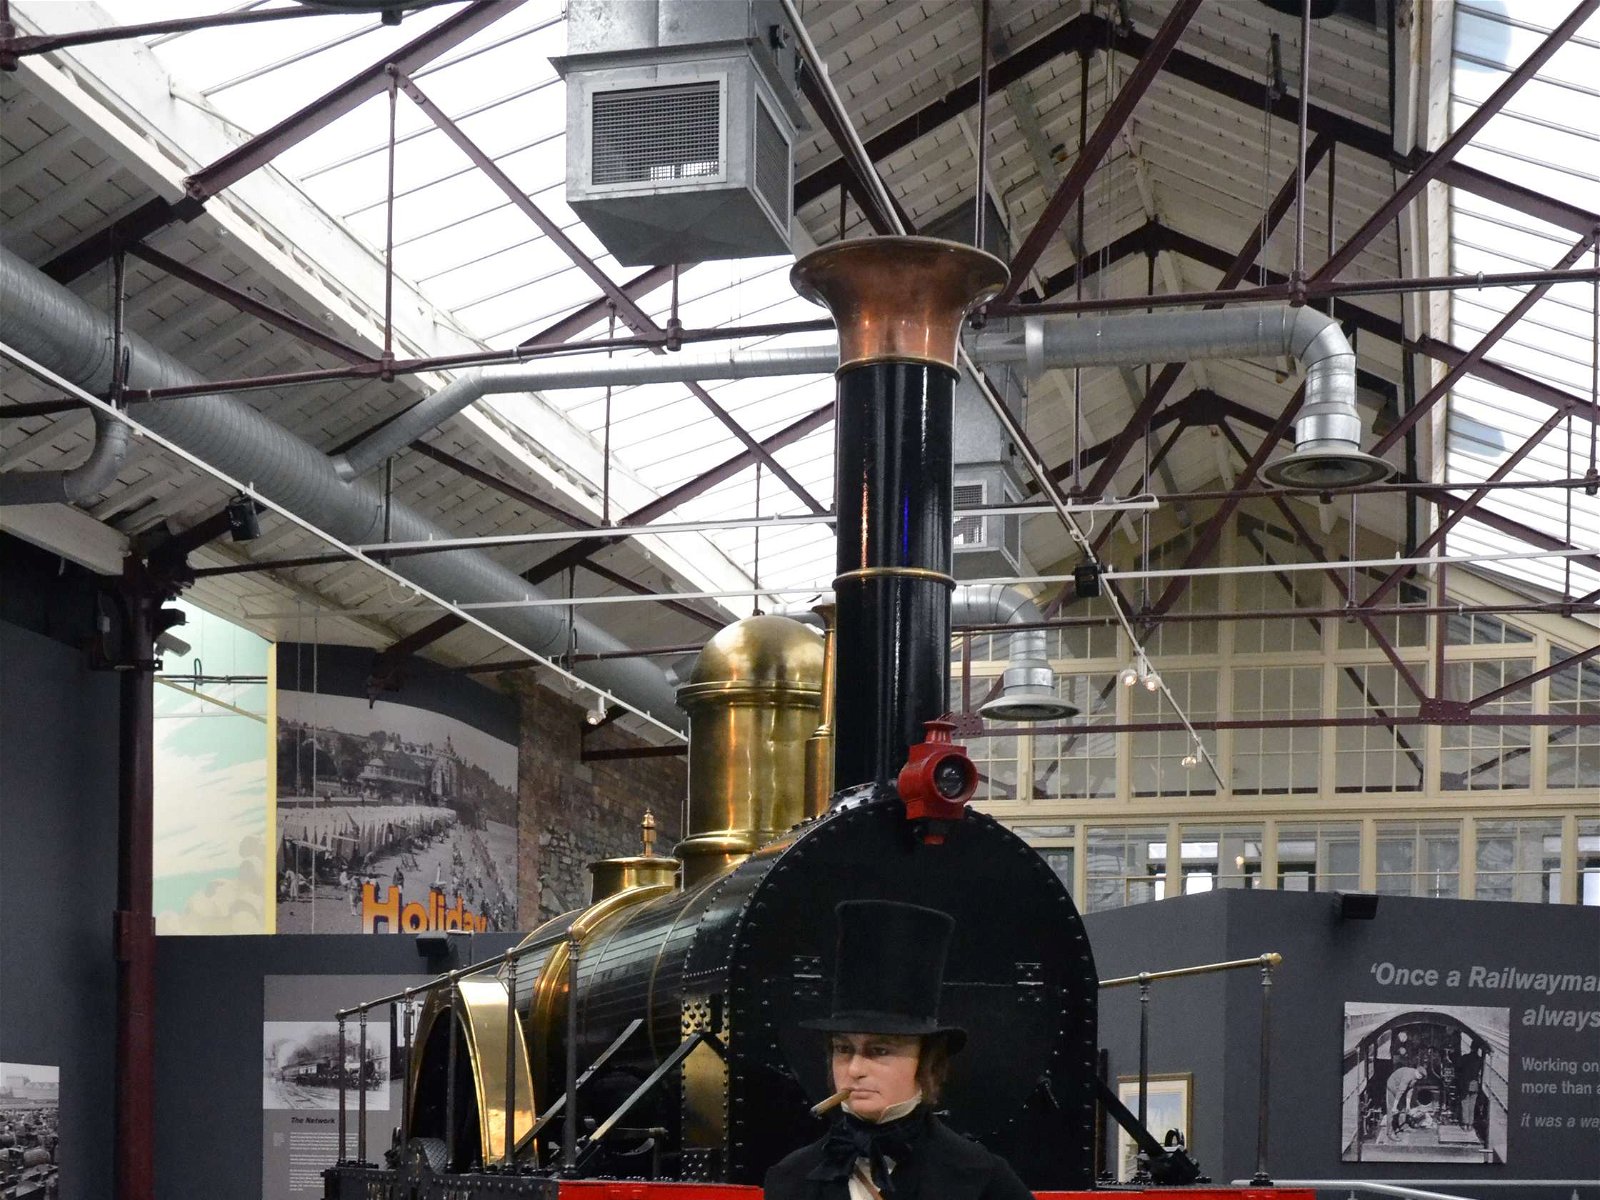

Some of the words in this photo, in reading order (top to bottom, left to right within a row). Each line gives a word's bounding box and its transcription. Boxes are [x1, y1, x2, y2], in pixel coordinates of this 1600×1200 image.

[362, 883, 487, 934] Holiday
[1446, 969, 1462, 988] a
[1468, 965, 1600, 996] Railwayma
[1522, 1004, 1600, 1033] always
[1521, 1056, 1578, 1075] Working
[1582, 1061, 1600, 1073] on
[1521, 1082, 1558, 1095] more
[1561, 1080, 1592, 1095] than
[290, 1116, 304, 1124] The
[305, 1116, 335, 1125] Network
[1520, 1112, 1531, 1128] it
[1534, 1116, 1563, 1128] was
[1566, 1116, 1576, 1128] a
[1580, 1116, 1600, 1132] wa
